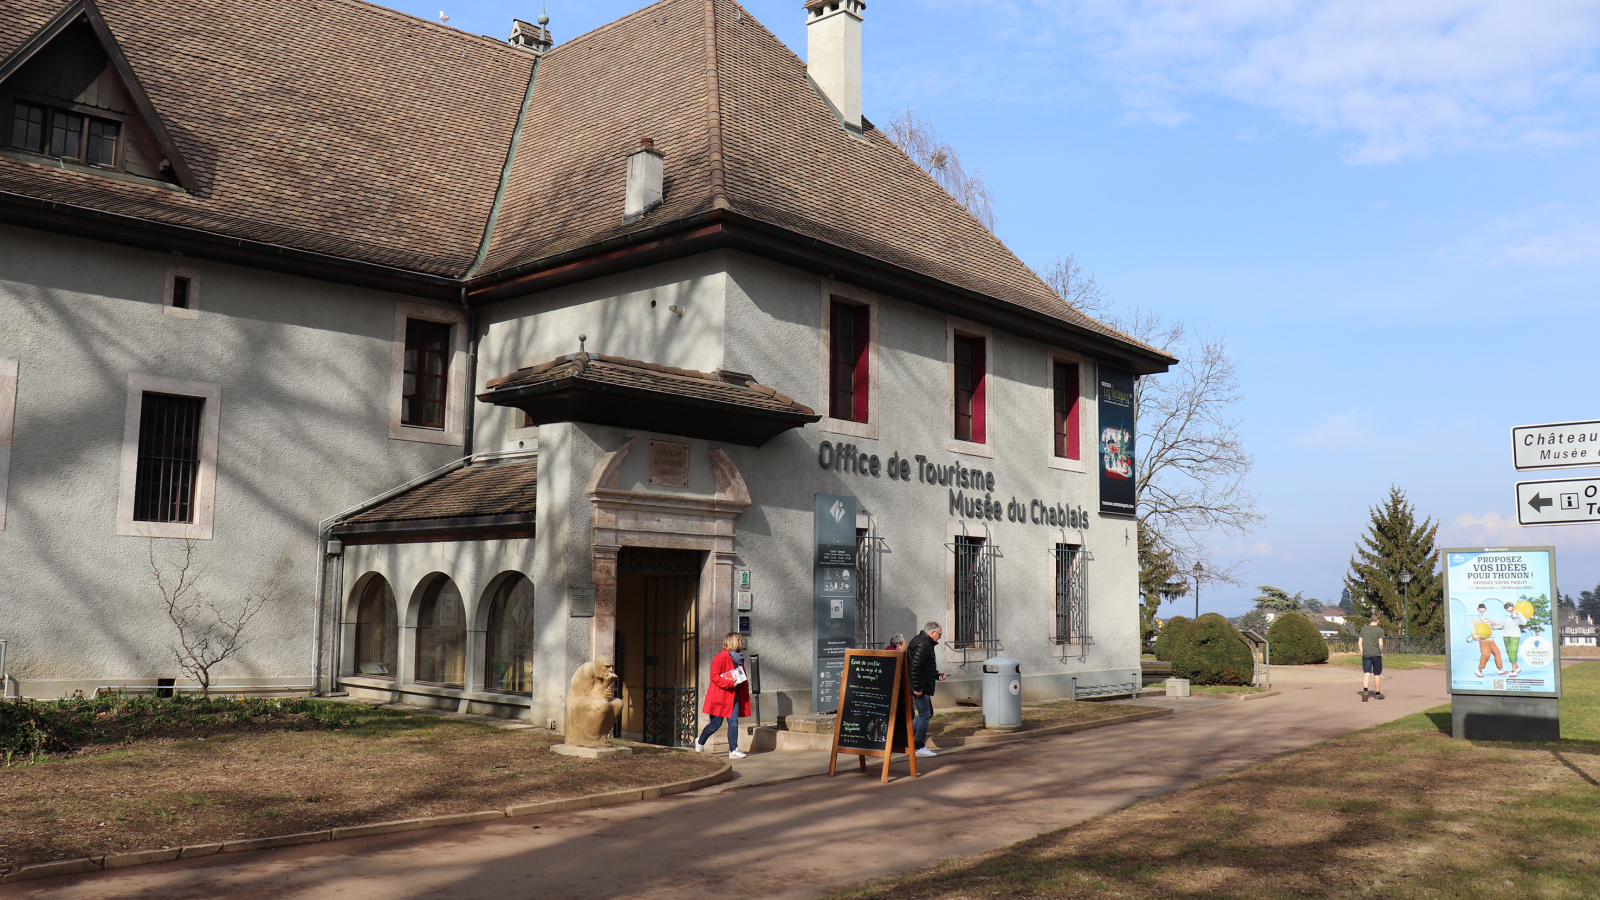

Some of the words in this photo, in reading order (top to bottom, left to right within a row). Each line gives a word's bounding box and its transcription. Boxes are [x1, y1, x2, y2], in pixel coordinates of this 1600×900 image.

[1524, 432, 1598, 446] Château
[1540, 448, 1587, 460] Musée
[819, 440, 880, 475] Office
[888, 451, 910, 480] de
[915, 455, 995, 492] Tourisme
[949, 488, 1002, 521] Musée
[1008, 496, 1026, 523] du
[1030, 499, 1089, 530] Chablais
[1473, 564, 1493, 572] VOS
